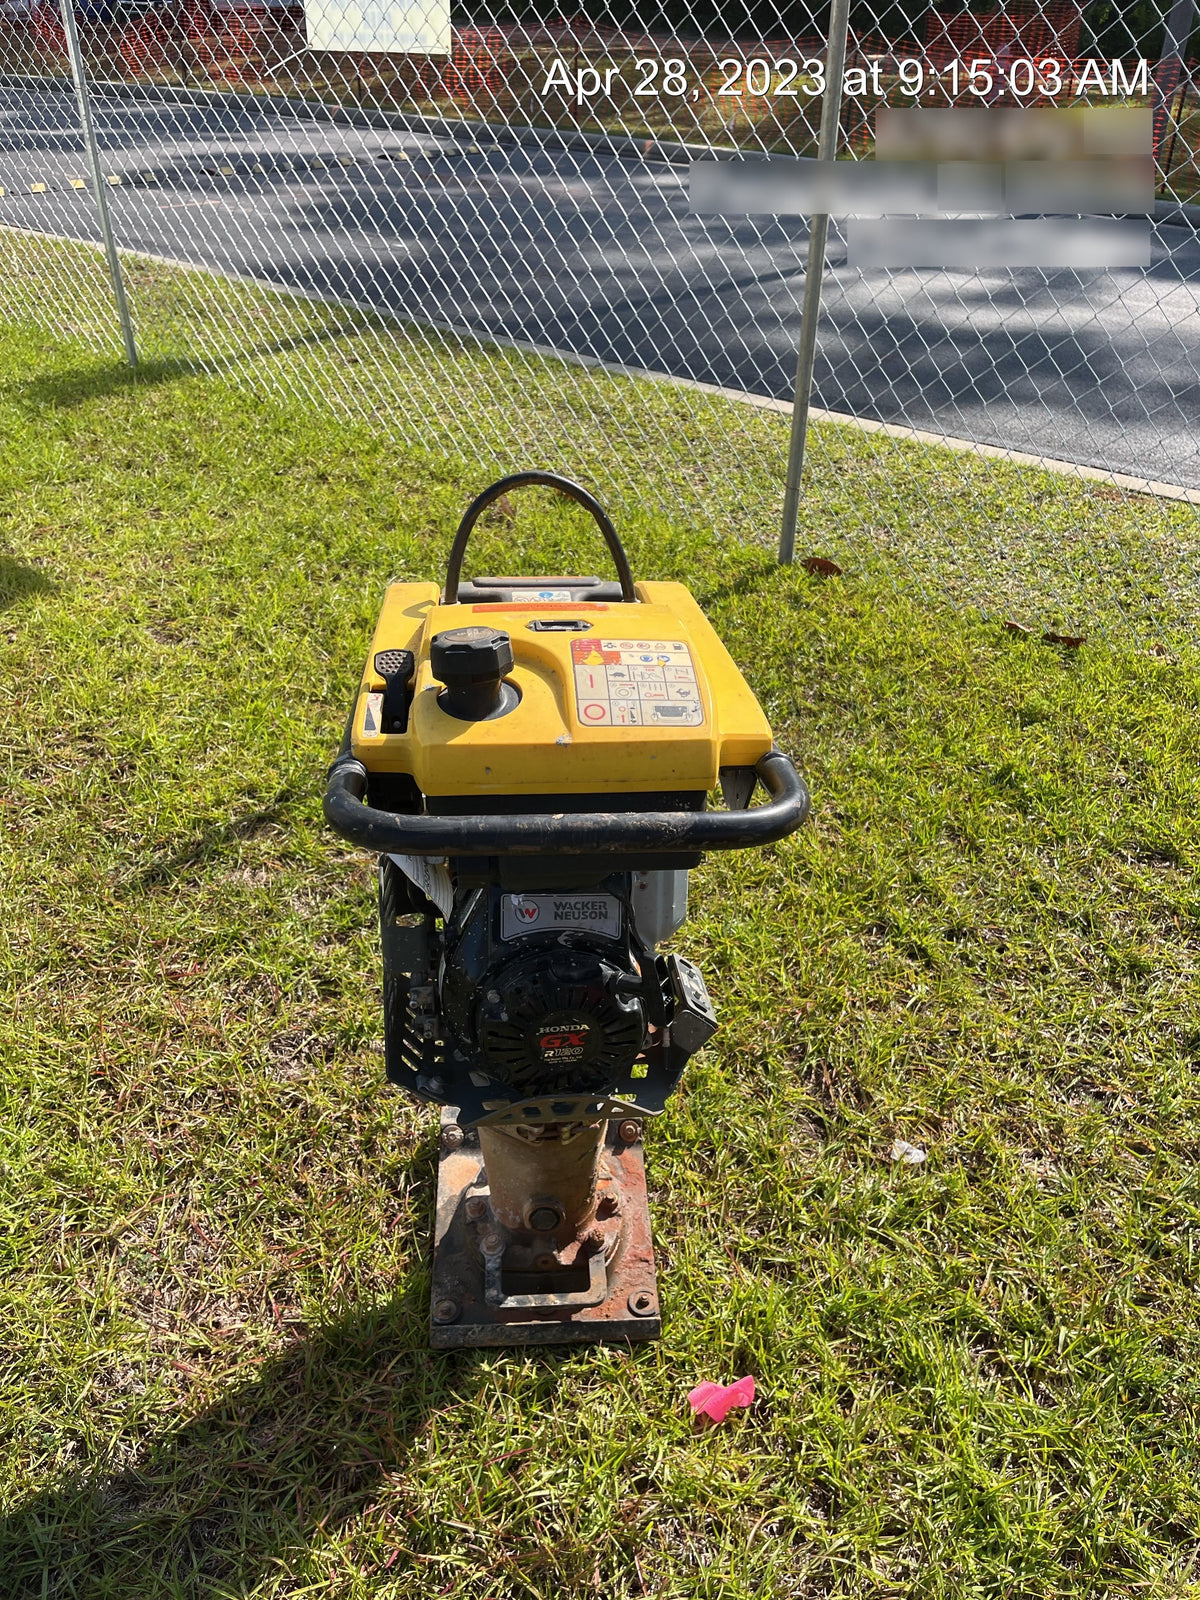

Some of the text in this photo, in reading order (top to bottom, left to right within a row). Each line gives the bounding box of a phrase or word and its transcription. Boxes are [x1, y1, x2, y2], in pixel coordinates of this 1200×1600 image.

[553, 901, 607, 911] WACKER
[553, 911, 608, 920] NEUSON
[539, 1024, 590, 1033] HONDA
[541, 1032, 588, 1048] GX
